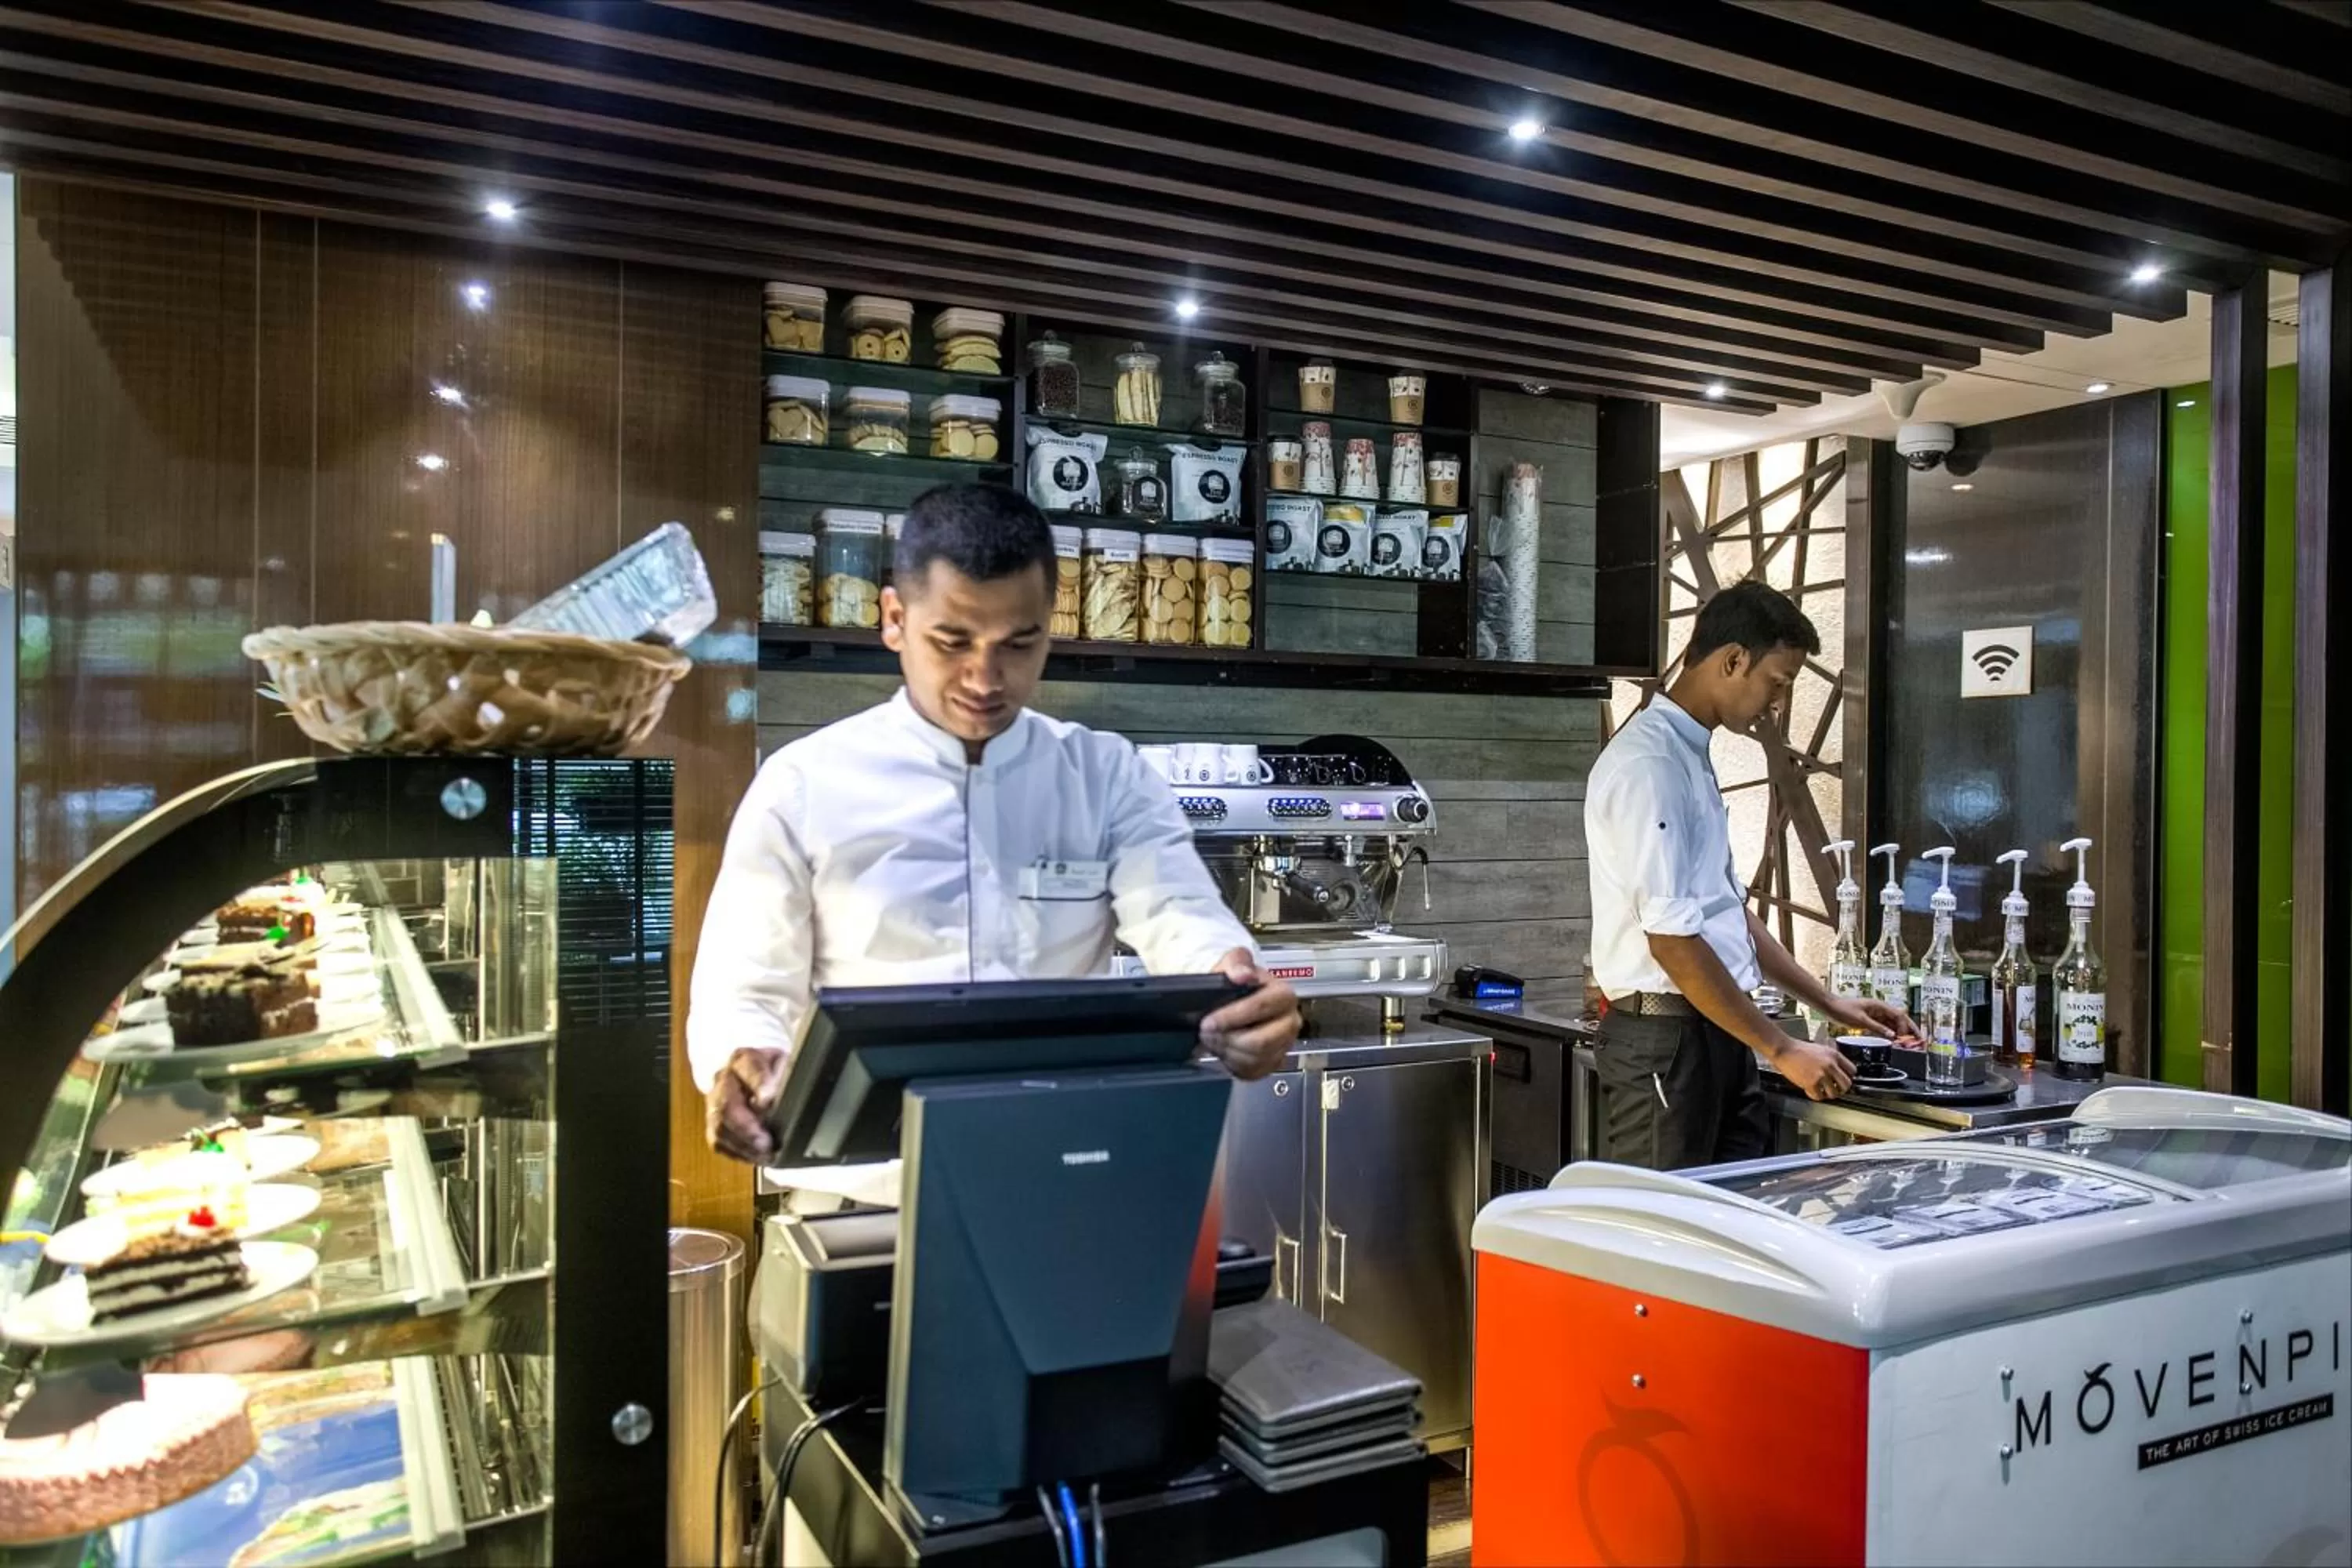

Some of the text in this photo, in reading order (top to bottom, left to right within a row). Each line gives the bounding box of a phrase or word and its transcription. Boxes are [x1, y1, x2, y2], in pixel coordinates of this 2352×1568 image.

[2145, 1400, 2328, 1461] THE ART OF SWISS ICE CREAM
